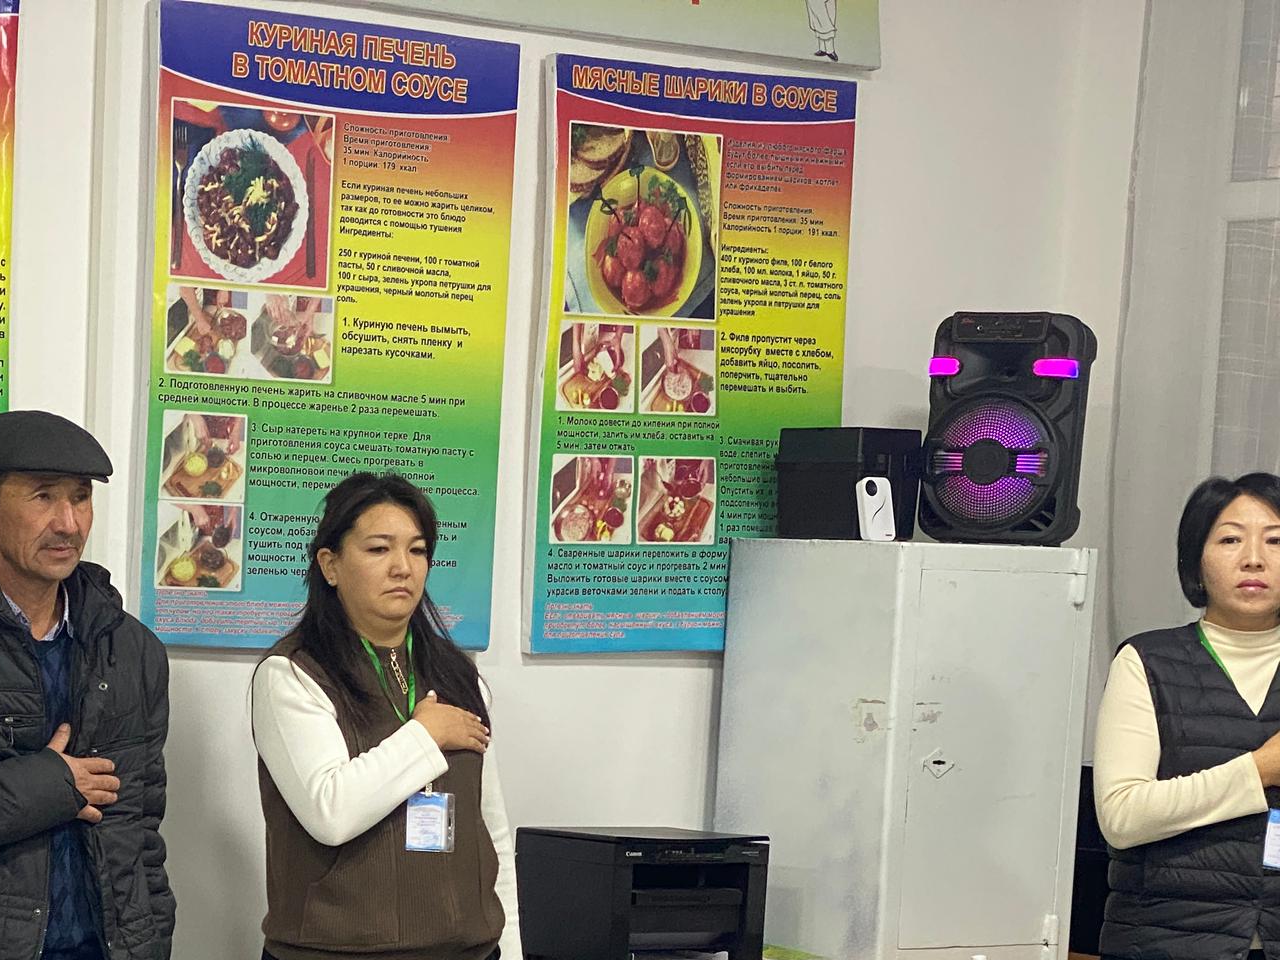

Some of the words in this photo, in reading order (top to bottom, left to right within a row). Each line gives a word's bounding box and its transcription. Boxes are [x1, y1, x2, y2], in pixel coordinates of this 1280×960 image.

[247, 20, 358, 58] КУРИНАЯ
[362, 35, 457, 69] ПЕЧЕНЬ
[231, 52, 250, 79] В
[254, 55, 387, 94] ТОМАТНОМ
[390, 71, 469, 103] СОУСЕ
[571, 65, 660, 97] МЯСНЫЕ
[663, 74, 748, 105] ШАРИКИ
[751, 82, 767, 107] В
[771, 84, 838, 113] СОУСЕ
[0, 257, 6, 267] с
[342, 316, 350, 327] 1.
[352, 317, 394, 332] Куриную
[395, 322, 429, 332] печень
[429, 325, 471, 337] вымыть,
[391, 335, 419, 345] снять
[420, 337, 453, 350] пленку
[456, 340, 463, 348] и
[750, 333, 793, 345] пропустит
[793, 336, 817, 347] через
[340, 345, 383, 356] нарезать
[384, 348, 435, 360] кусочками.
[720, 344, 762, 357] мясорубку
[157, 377, 167, 388] 2.
[168, 378, 249, 395] Подготовленную
[250, 385, 286, 395] печень
[286, 387, 322, 398] жарить
[323, 389, 335, 398] на
[336, 390, 389, 401] сливочном
[389, 393, 419, 403] масле
[419, 393, 427, 404] 5
[427, 395, 447, 405] мин
[447, 397, 465, 408] при
[546, 587, 580, 597] украсив
[581, 587, 628, 595] веточками
[660, 587, 666, 595] и
[667, 587, 696, 597] подать
[696, 587, 703, 596] к
